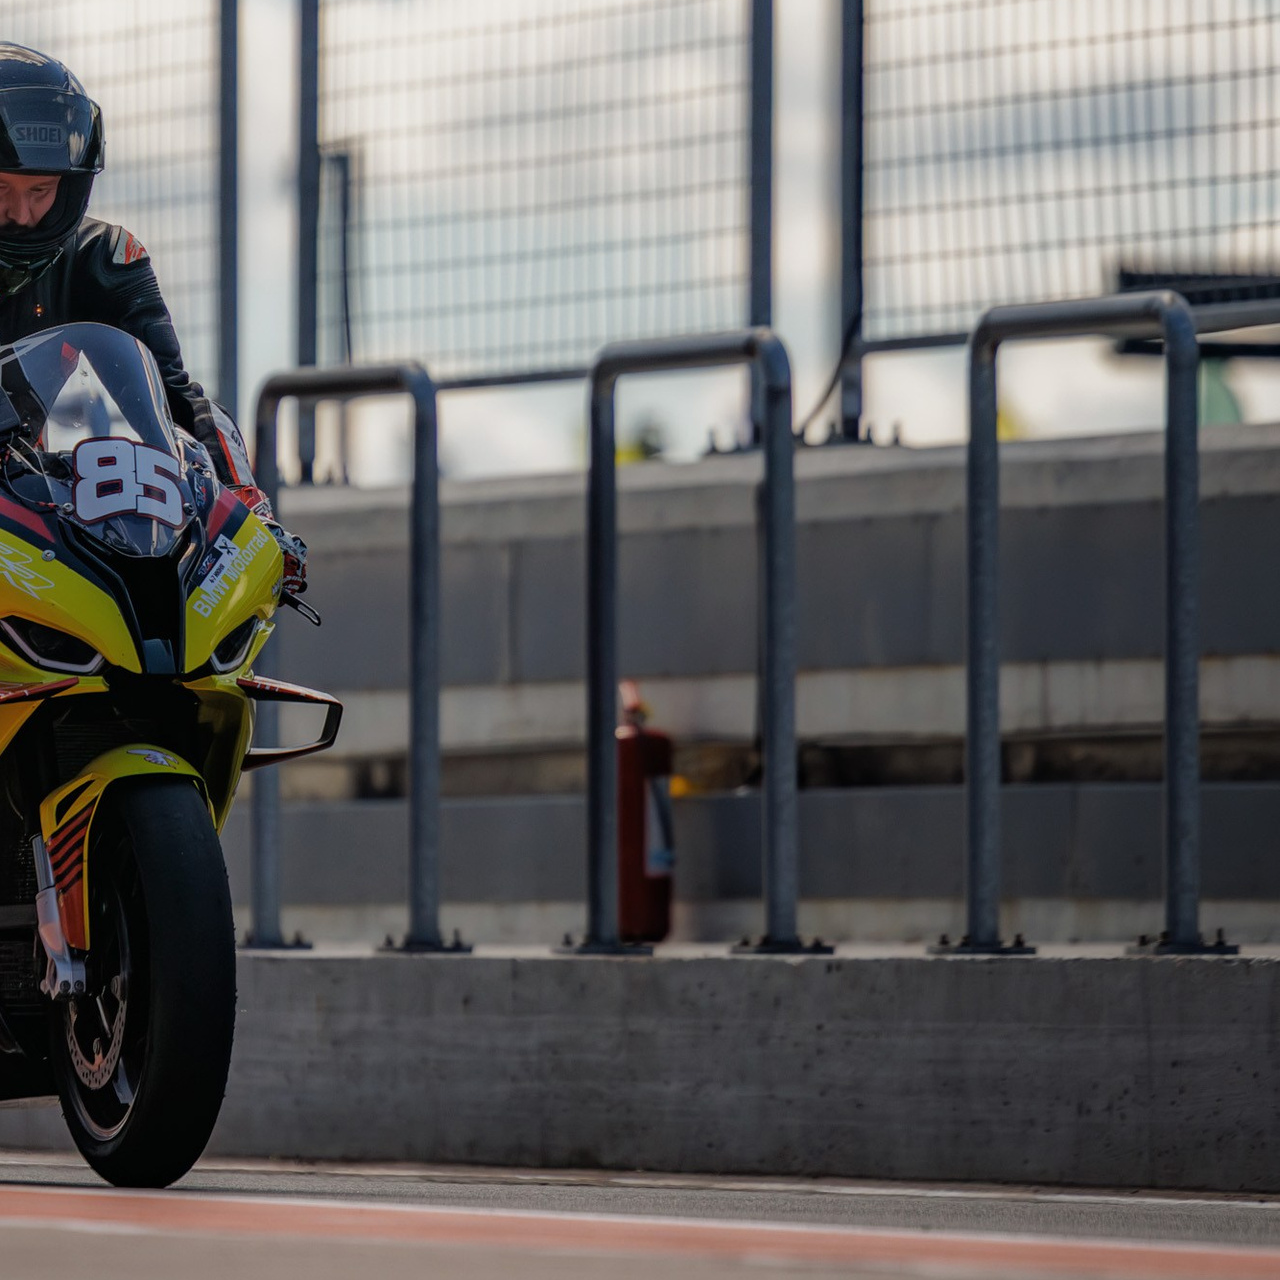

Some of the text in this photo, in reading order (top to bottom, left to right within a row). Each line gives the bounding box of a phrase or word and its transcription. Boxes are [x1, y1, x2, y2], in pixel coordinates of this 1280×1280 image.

[14, 126, 61, 143] SHOEI
[71, 436, 184, 530] 85
[192, 578, 230, 618] BMW
[225, 527, 269, 582] Motorrad
